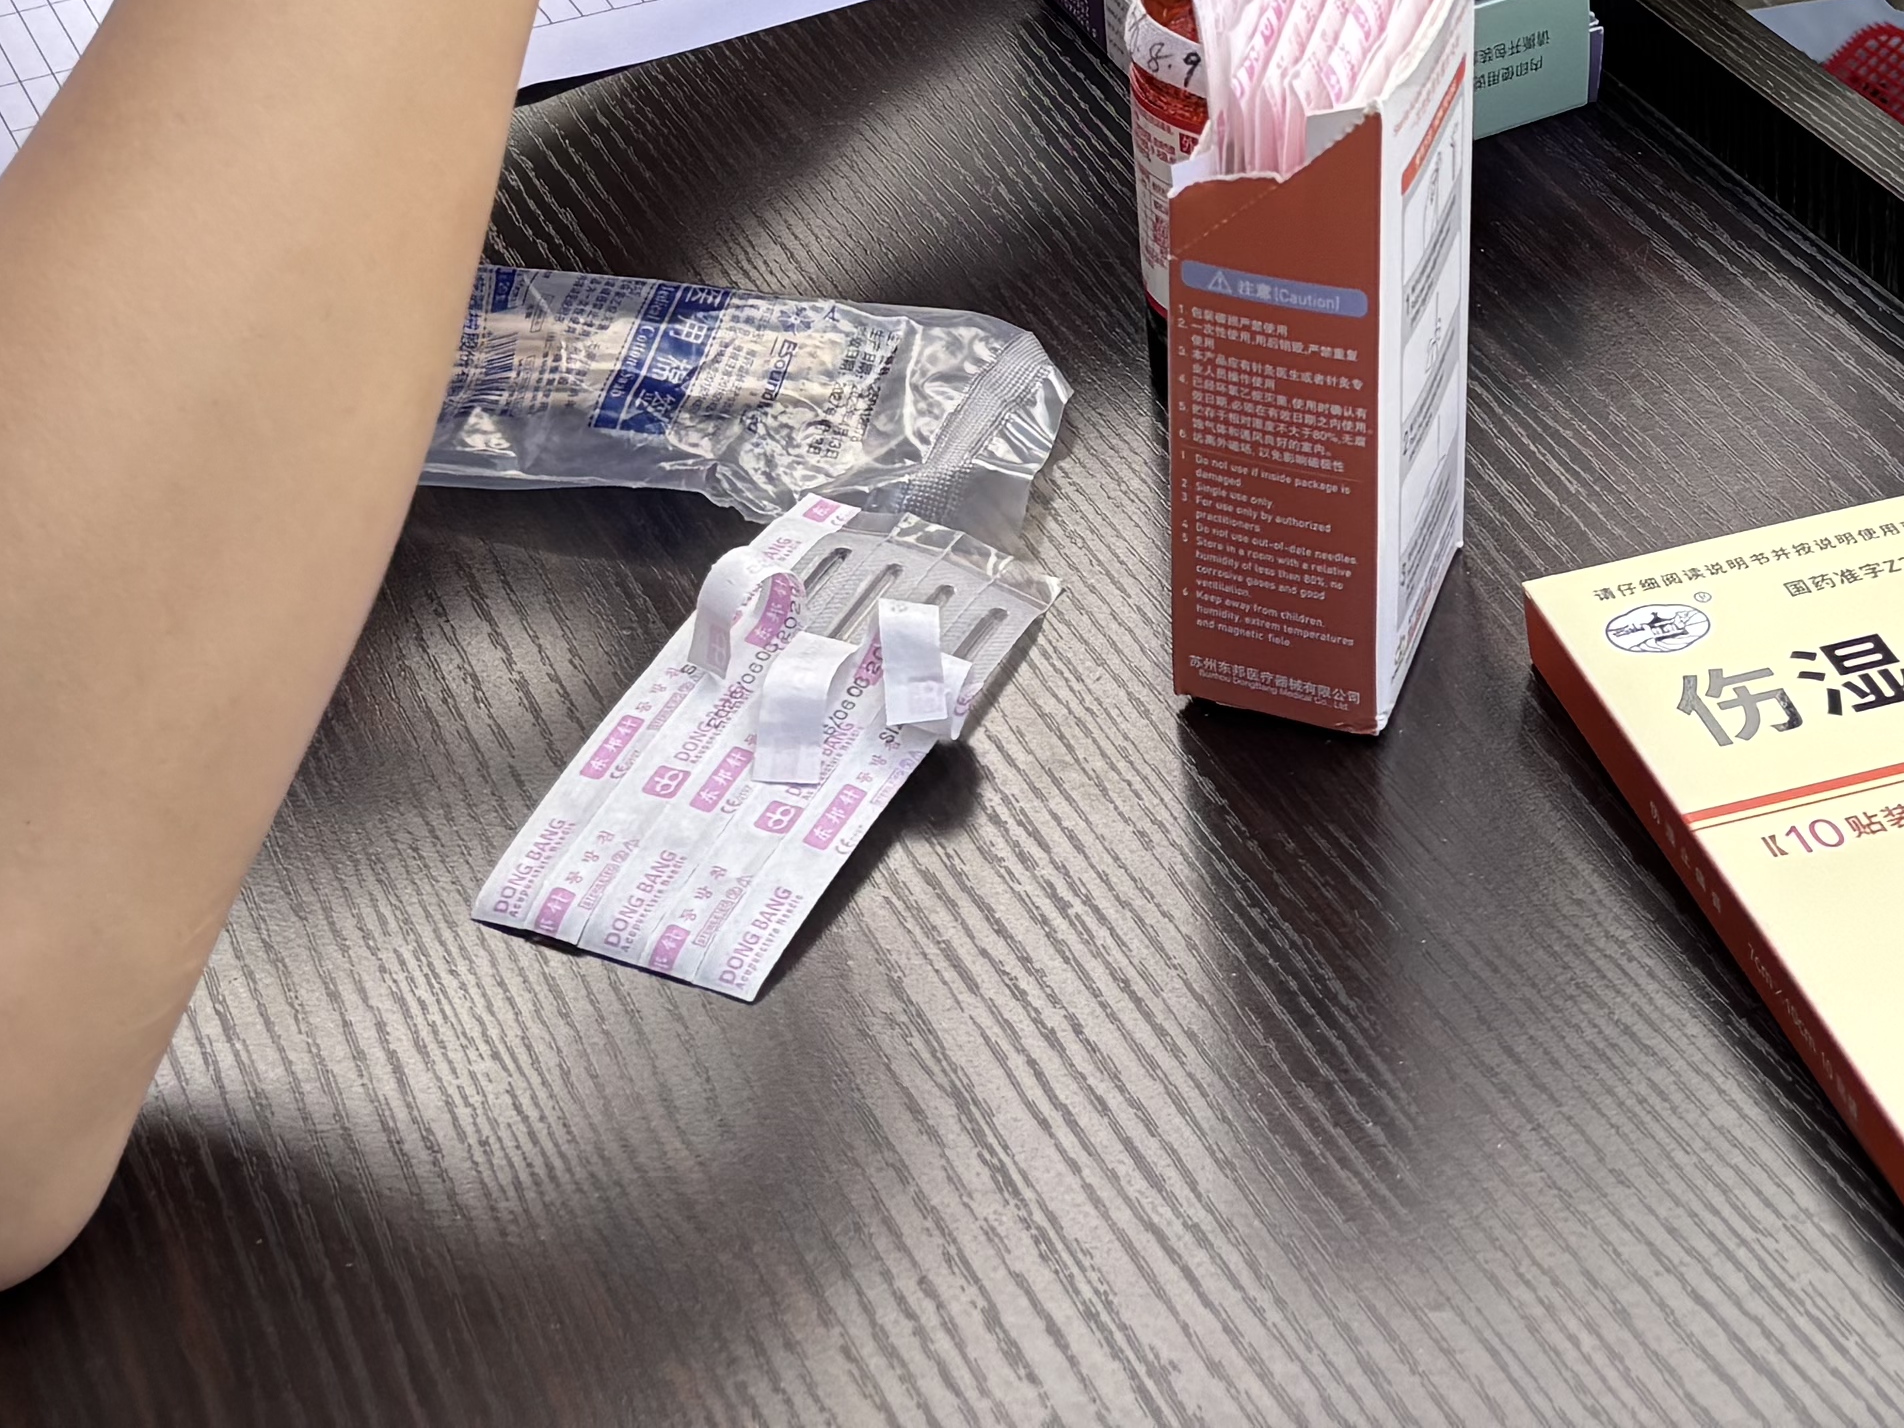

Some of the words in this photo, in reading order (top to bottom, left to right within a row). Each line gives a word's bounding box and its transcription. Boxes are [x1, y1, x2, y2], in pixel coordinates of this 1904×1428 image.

[1239, 278, 1270, 300] 注意
[625, 324, 655, 368] Cotton
[634, 285, 723, 426] 医用棉签
[1191, 334, 1215, 349] 使用
[1195, 453, 1208, 465] Do
[1211, 457, 1227, 469] not
[1294, 475, 1338, 495] package
[1341, 484, 1350, 494] is
[1195, 481, 1226, 498] Single
[1229, 491, 1247, 502] use
[1195, 495, 1212, 508] For
[1216, 501, 1232, 512] use
[1236, 506, 1258, 520] only
[1260, 512, 1272, 523] by
[1274, 513, 1331, 534] authorized
[1196, 523, 1208, 534] Do
[1212, 527, 1228, 538] not
[1231, 532, 1248, 543] use
[1251, 536, 1311, 556] out-of-date
[1196, 536, 1222, 551] Store
[1226, 543, 1236, 554] in
[1247, 550, 1274, 563] room
[1277, 554, 1298, 568] with
[1311, 561, 1351, 579] relative
[1195, 550, 1239, 570] humidity
[1254, 564, 1275, 577] less
[1278, 569, 1300, 582] than
[1196, 564, 1243, 582] corrosive
[1245, 577, 1276, 592] gases
[1278, 582, 1296, 595] and
[1299, 586, 1325, 602] good
[1196, 589, 1221, 606] Keep
[1224, 597, 1250, 612] away
[1253, 602, 1277, 617] from
[1196, 617, 1214, 629] and
[1217, 623, 1264, 641] magnetic
[1283, 623, 1354, 648] temperatures
[1188, 653, 1360, 705] 苏州东邦医疗器械有限公司
[697, 750, 748, 802] 东邦针
[811, 789, 860, 840] 东邦针
[490, 863, 534, 913] DONG
[524, 816, 566, 861] BANG
[601, 896, 648, 947] DONG
[636, 849, 679, 894] BANG
[715, 933, 763, 983] DONG
[751, 886, 794, 930] BANG
